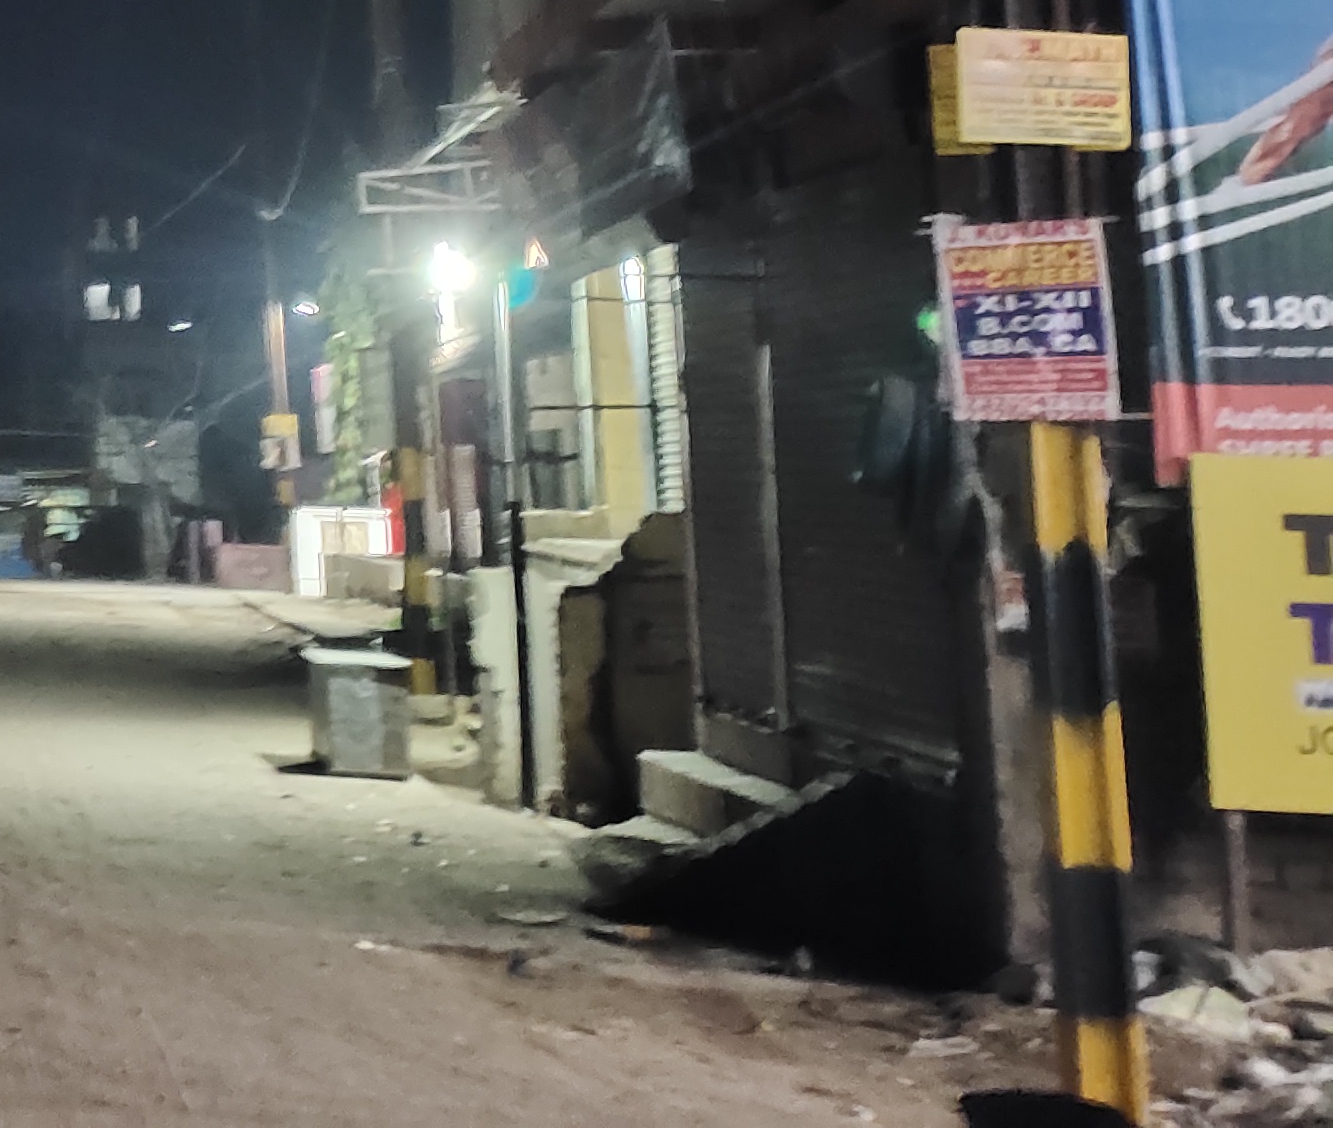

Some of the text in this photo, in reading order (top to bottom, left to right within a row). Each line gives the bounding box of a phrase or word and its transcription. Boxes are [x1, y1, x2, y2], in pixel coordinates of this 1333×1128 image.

[952, 242, 1095, 272] COMMERCE
[1247, 295, 1333, 331] 180
[1215, 404, 1333, 431] Authori
